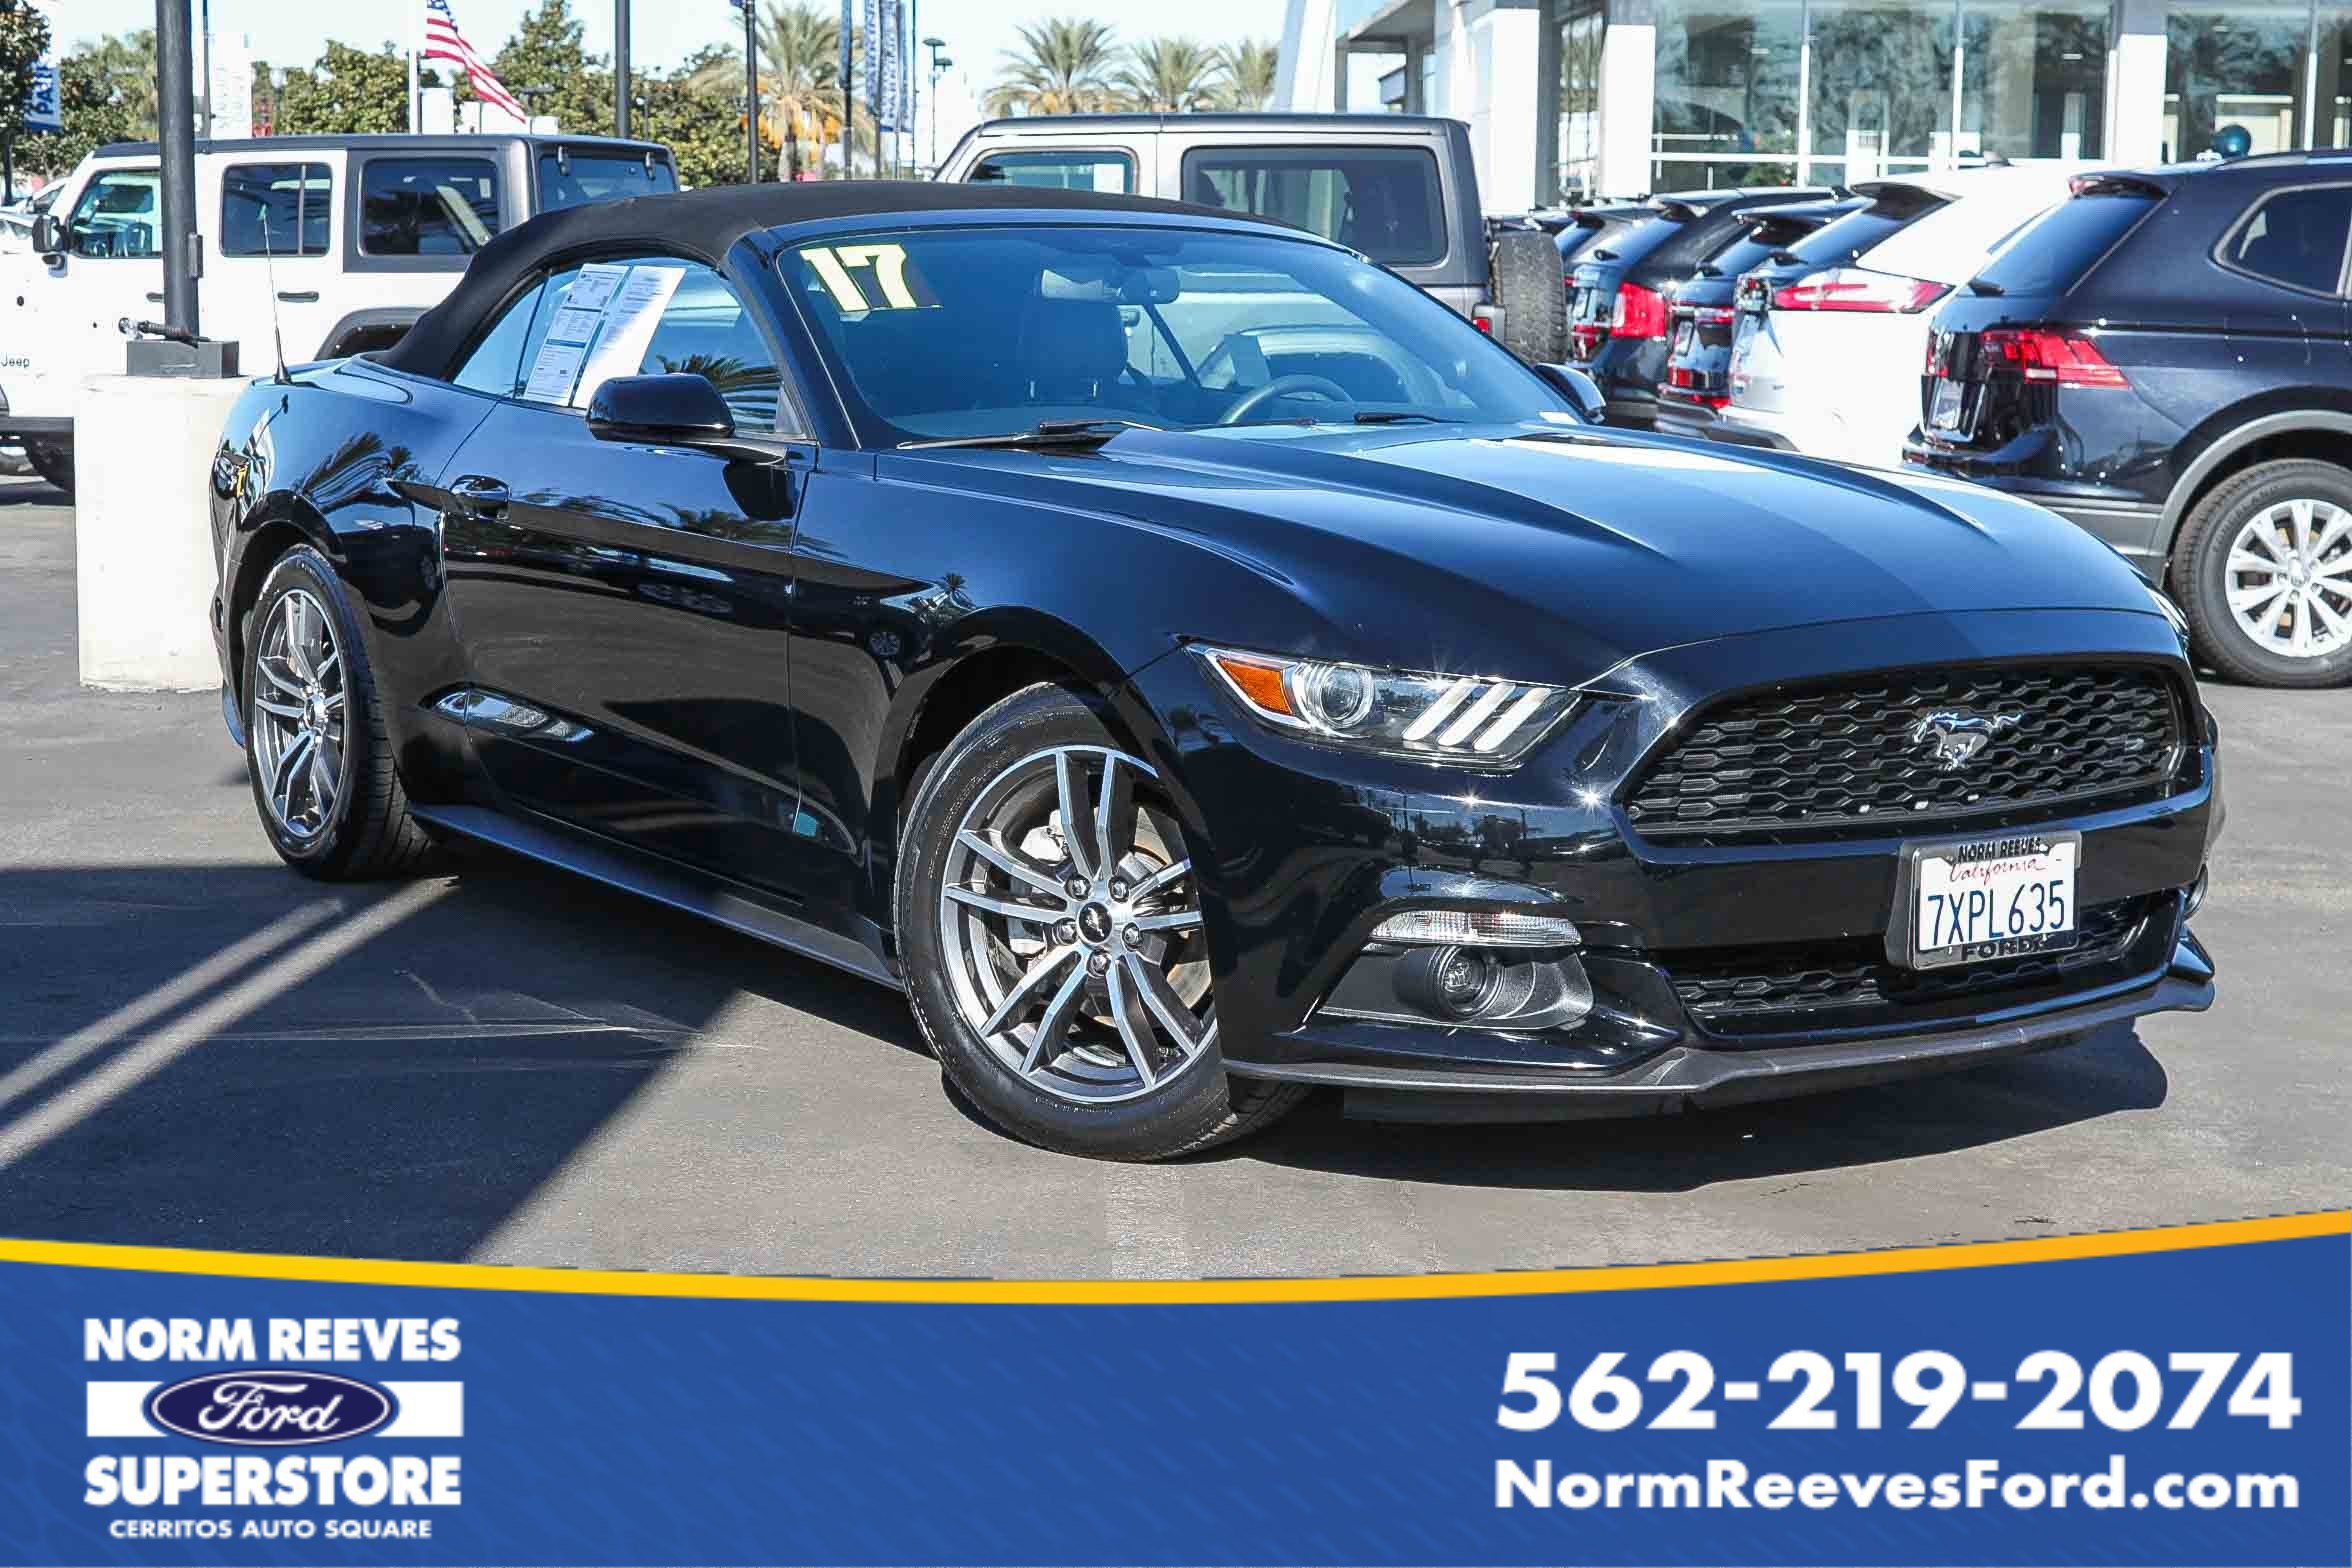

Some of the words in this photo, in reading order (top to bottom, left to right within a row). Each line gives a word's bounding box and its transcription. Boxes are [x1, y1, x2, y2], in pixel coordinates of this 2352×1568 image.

[800, 244, 917, 312] 17
[0, 351, 30, 369] Jeep
[1957, 841, 1996, 864] NORM
[1950, 858, 2047, 885] California
[1928, 880, 2064, 946] 7XPL635
